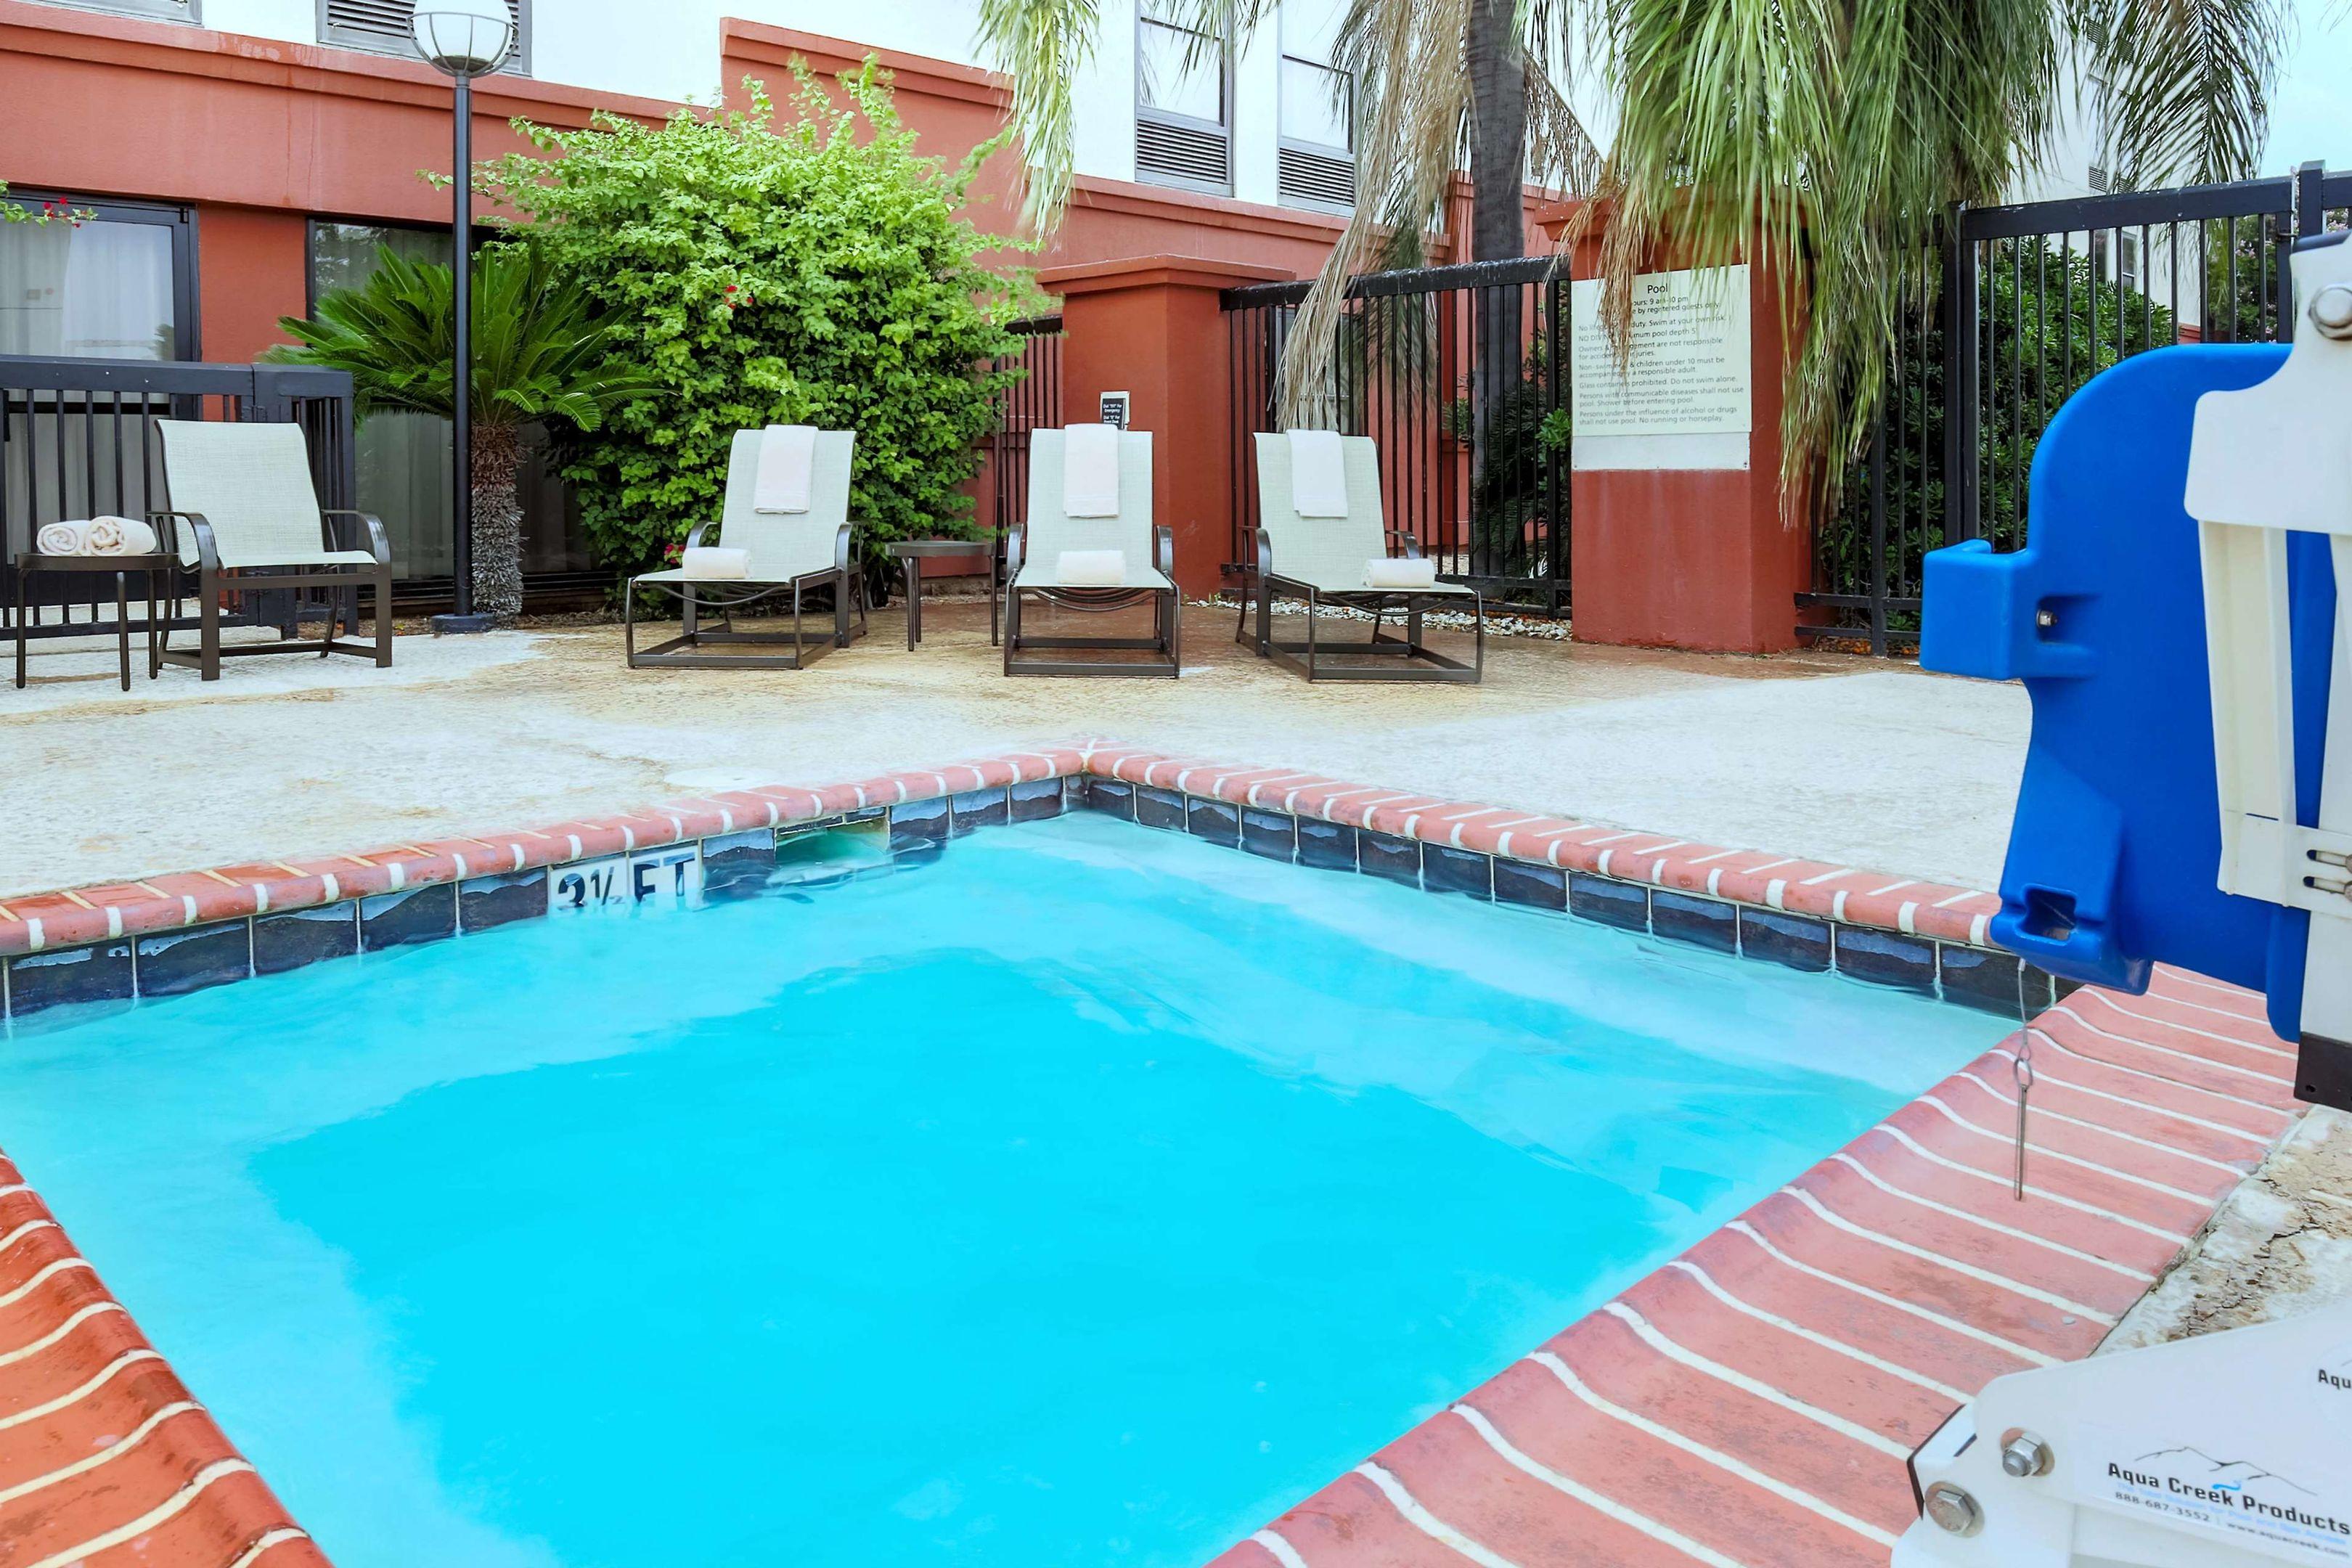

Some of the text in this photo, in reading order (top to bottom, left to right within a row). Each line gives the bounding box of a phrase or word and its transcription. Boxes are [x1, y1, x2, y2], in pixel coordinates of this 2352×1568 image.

[1648, 283, 1667, 293] Pool
[1683, 337, 1723, 346] responsible
[1638, 367, 1676, 376] responsible
[1621, 389, 1669, 398] communicable
[2108, 1462, 2159, 1488] Aqua
[2168, 1477, 2233, 1506] Creek
[2243, 1495, 2350, 1535] Products
[2115, 1492, 2210, 1521] 888-687-3552
